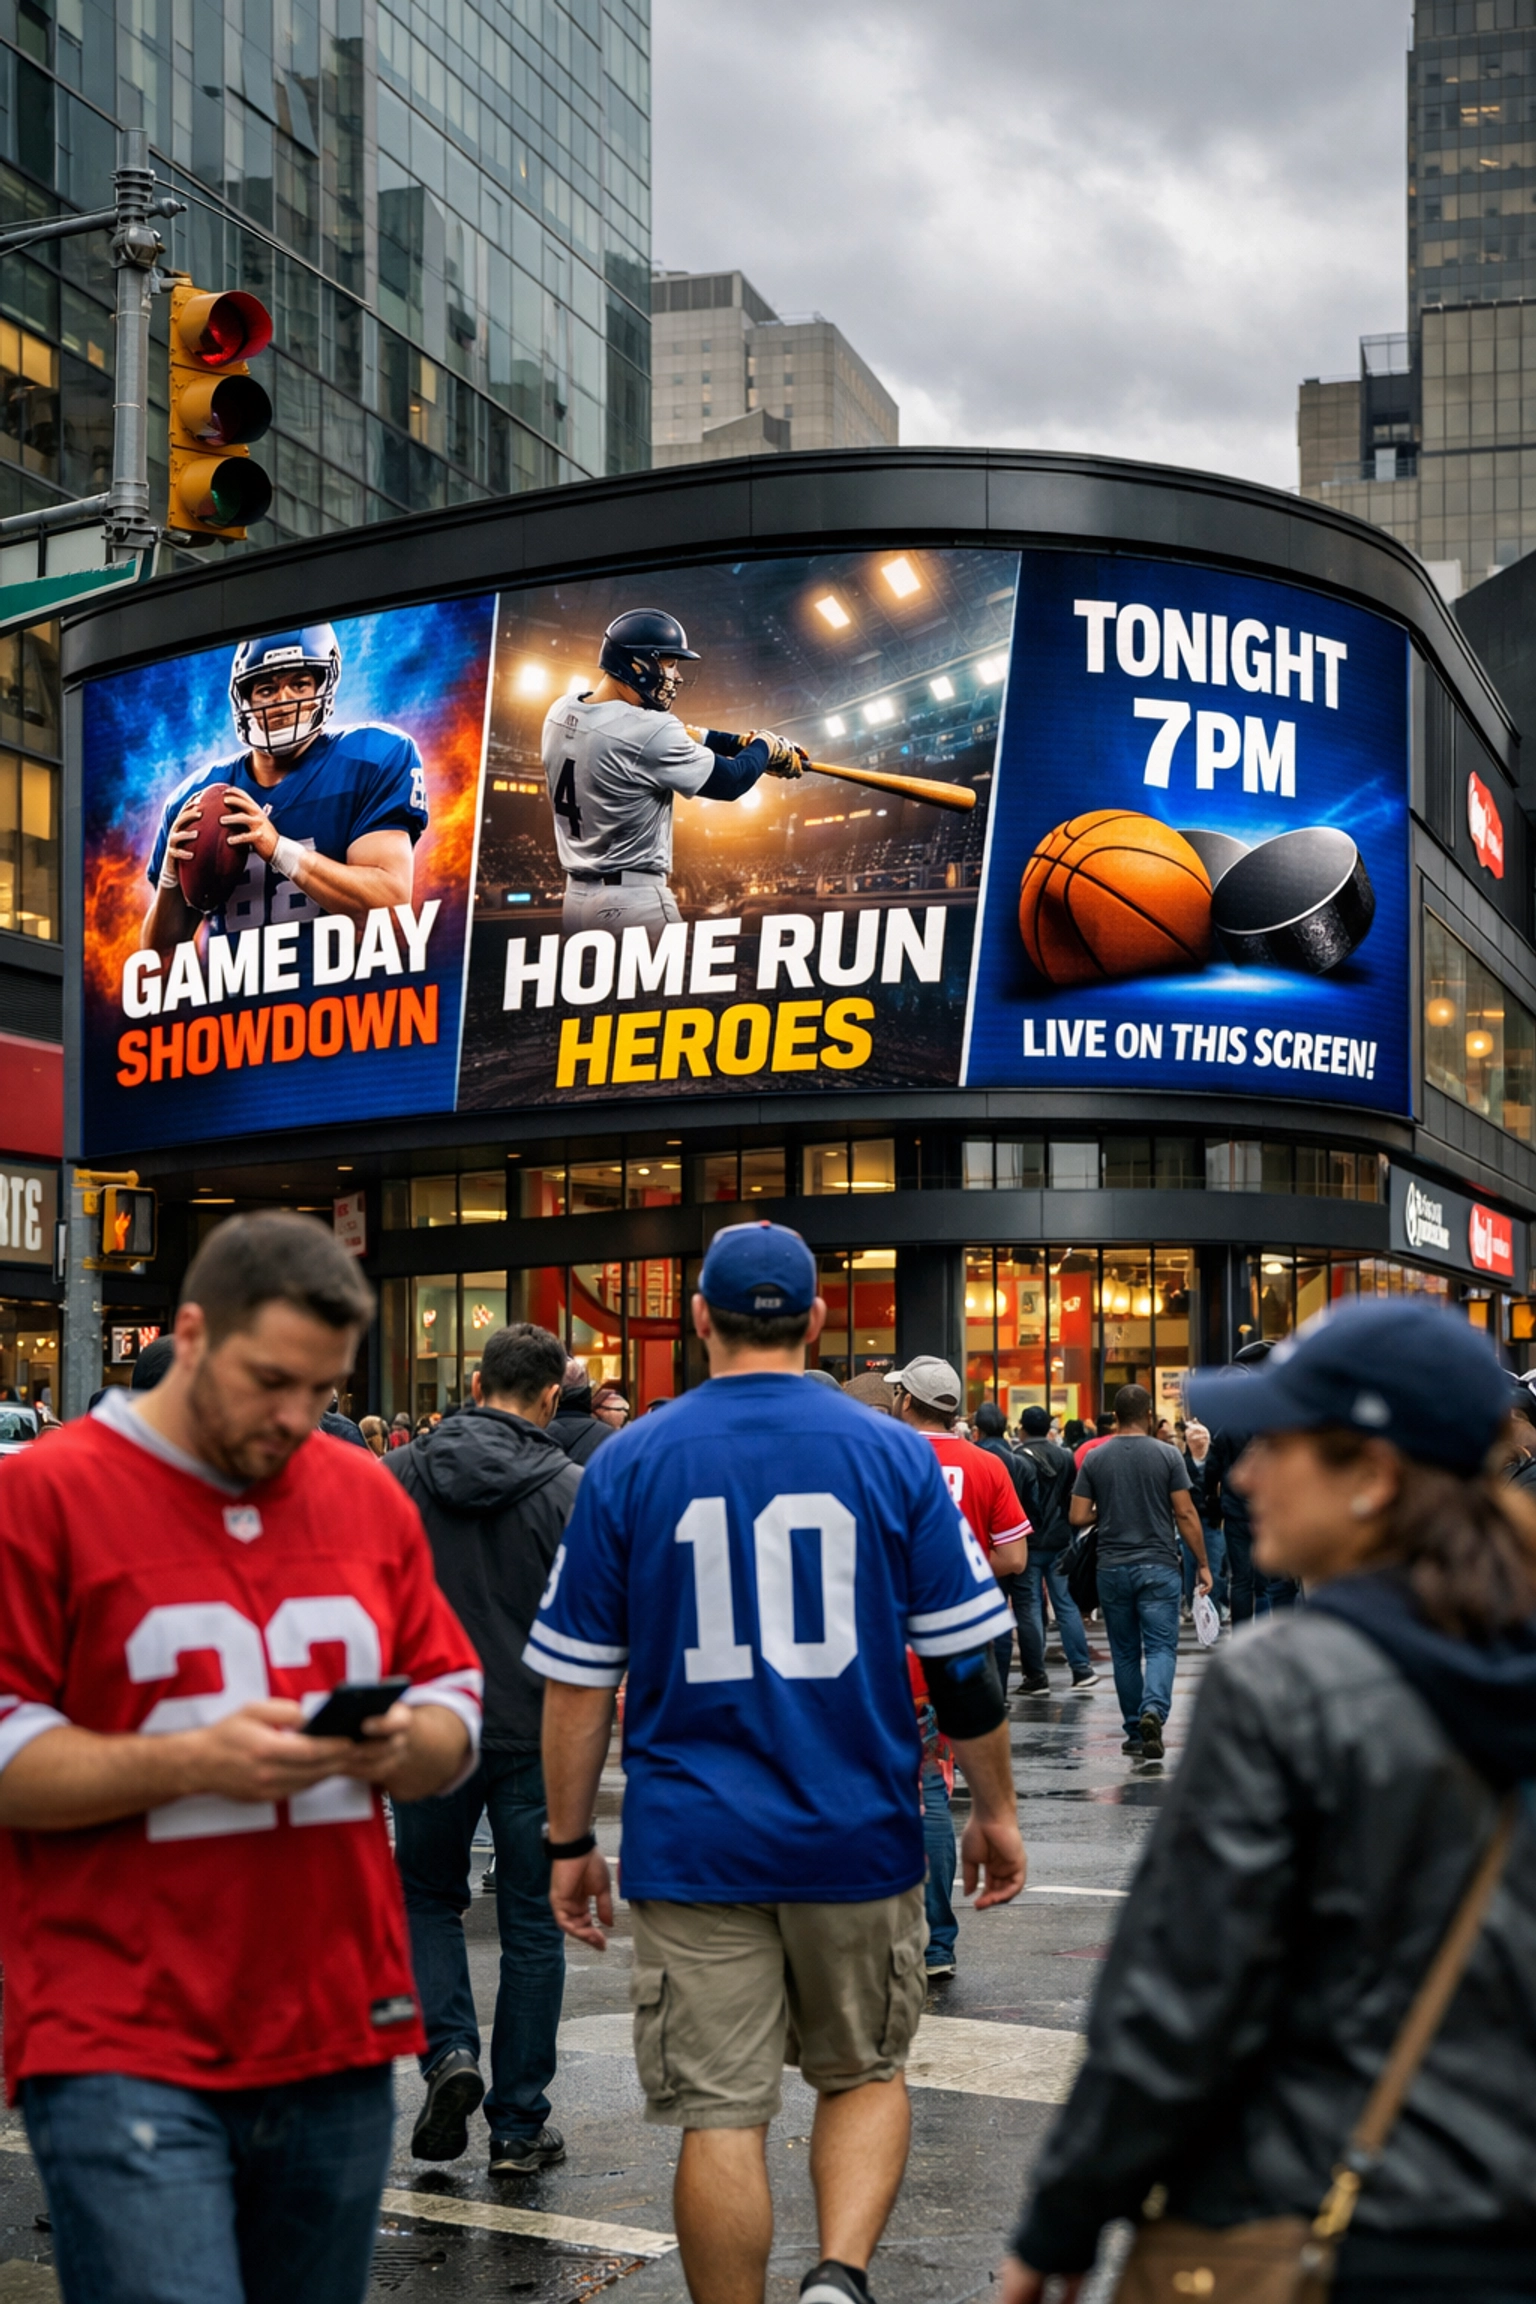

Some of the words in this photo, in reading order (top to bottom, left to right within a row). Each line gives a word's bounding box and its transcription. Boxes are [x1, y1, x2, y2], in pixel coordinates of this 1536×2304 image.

[1073, 599, 1347, 710] TONIGHT
[554, 757, 582, 841] 4
[1133, 697, 1296, 798] 7PM
[122, 921, 301, 1019] GAME
[312, 899, 442, 986] DAY
[502, 917, 742, 1011] HOME
[756, 905, 947, 990] RUN
[116, 984, 439, 1087] SHOWDOWN
[556, 997, 875, 1088] HEROES
[1022, 1018, 1107, 1058] LIVE
[1115, 1022, 1163, 1060] ON
[1171, 1023, 1248, 1065] THIS
[1253, 1028, 1378, 1080] SCREEN!
[674, 1492, 858, 1684] 10
[124, 1594, 382, 1842] 22
